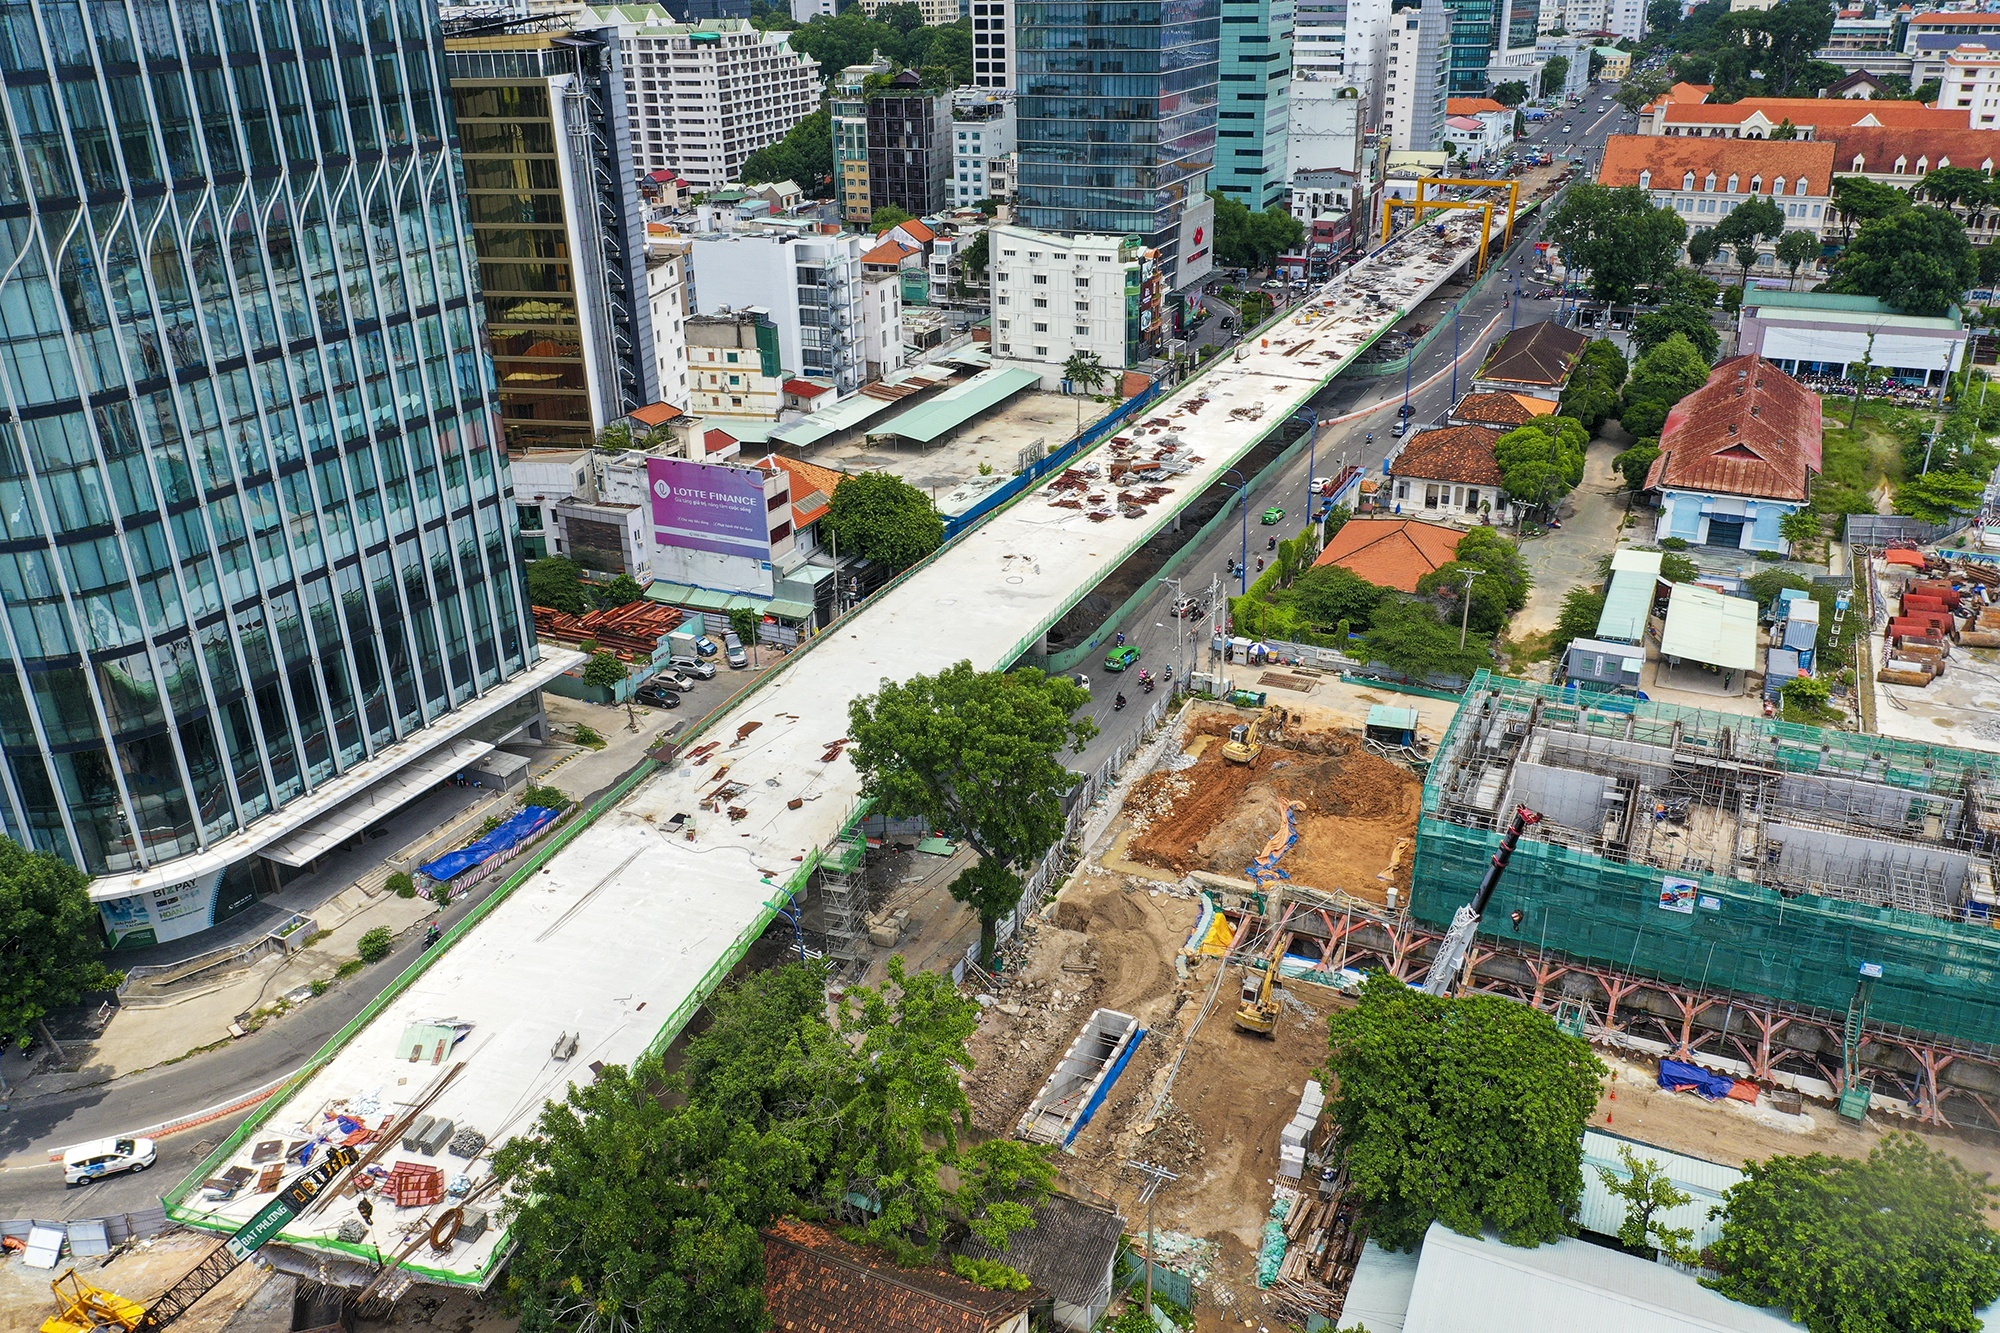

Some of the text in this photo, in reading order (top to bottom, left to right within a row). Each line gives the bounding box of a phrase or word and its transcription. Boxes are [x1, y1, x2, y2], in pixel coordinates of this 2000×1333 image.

[673, 487, 757, 506] LOTTE FINANCE
[152, 878, 197, 898] BIZPAY
